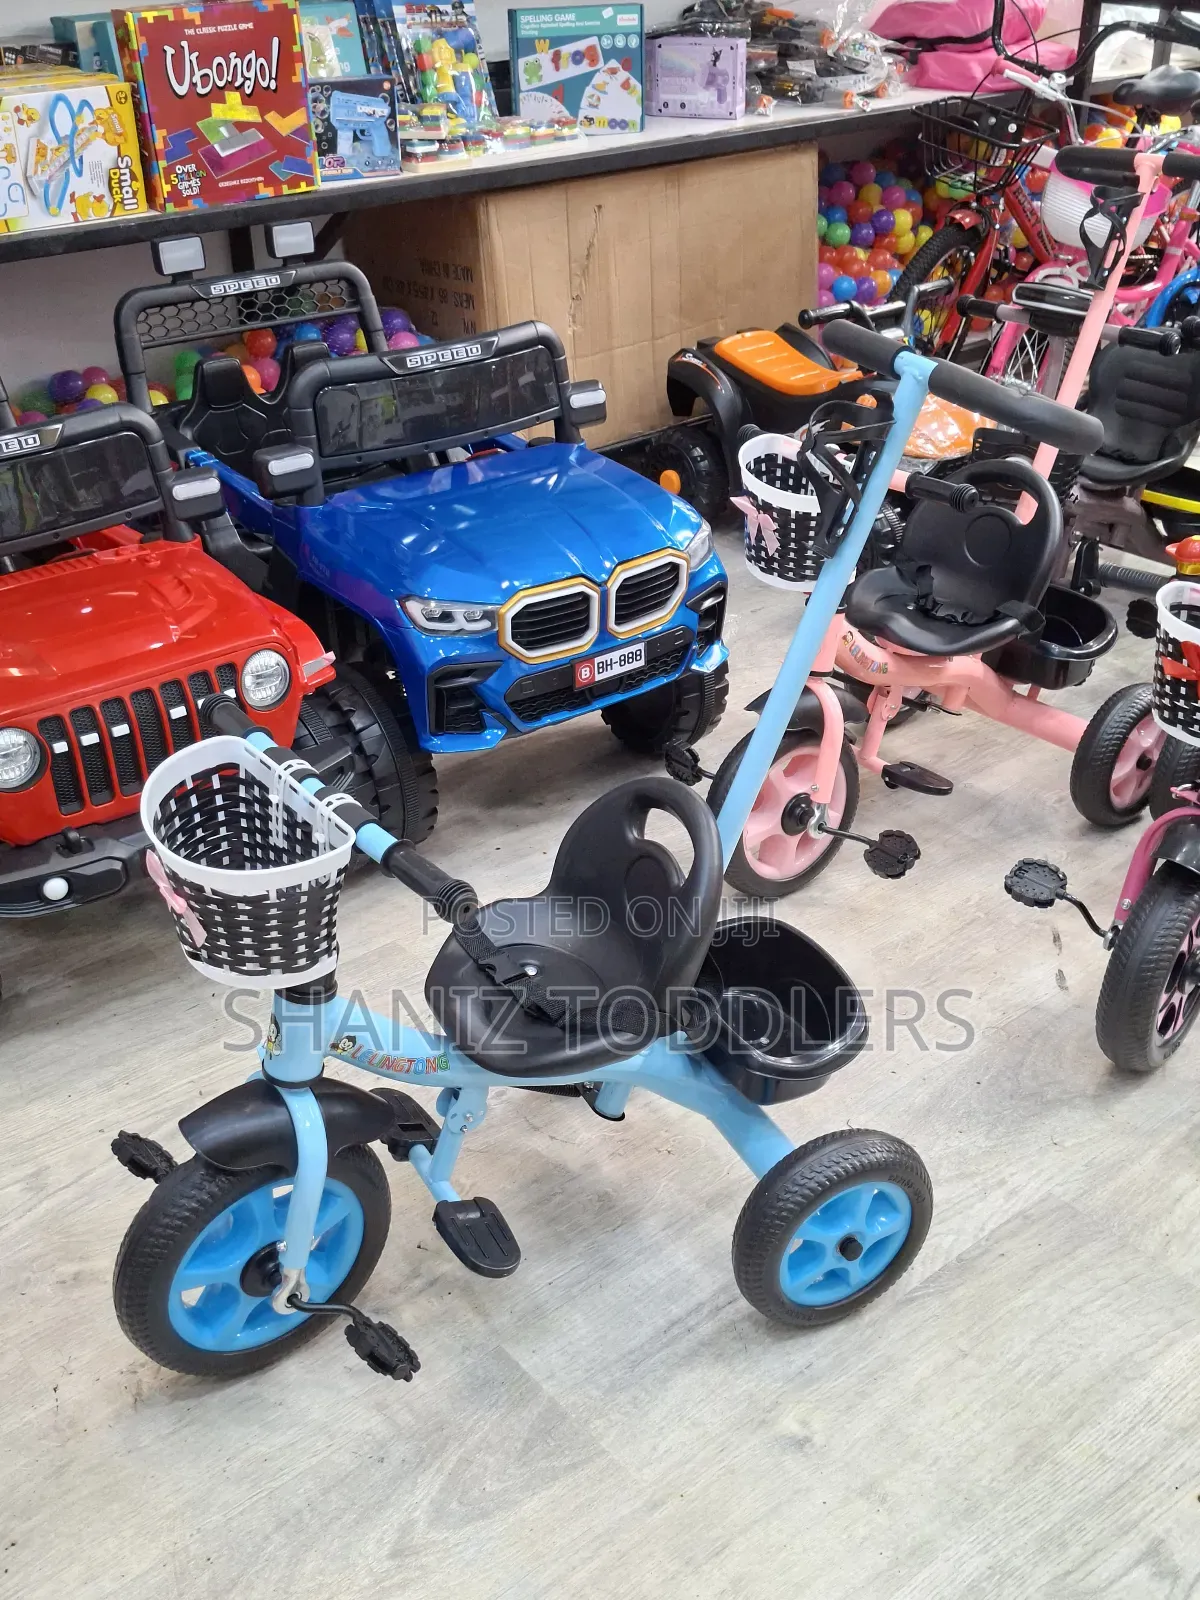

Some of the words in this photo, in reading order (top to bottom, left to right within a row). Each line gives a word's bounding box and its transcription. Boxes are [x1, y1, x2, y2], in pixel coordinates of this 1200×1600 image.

[196, 26, 217, 34] CLASSIC
[217, 24, 238, 32] PUZZLE
[238, 22, 254, 30] GAME
[520, 14, 553, 23] SPELLING
[554, 13, 576, 21] GAME
[163, 36, 280, 97] Ubongo!
[111, 113, 123, 134] Small
[170, 173, 179, 185] 5
[178, 170, 207, 181] MILLION
[176, 164, 197, 173] OVER
[109, 168, 122, 203] Duck
[118, 156, 139, 210] Small
[177, 178, 201, 190] GAMES
[181, 187, 200, 197] SOLD!
[210, 275, 281, 295] SPEED
[406, 344, 482, 368] SPEED
[0, 433, 41, 453] ED
[581, 667, 590, 679] B
[597, 648, 643, 675] BH-888
[350, 1043, 451, 1075] LELINGTONG
